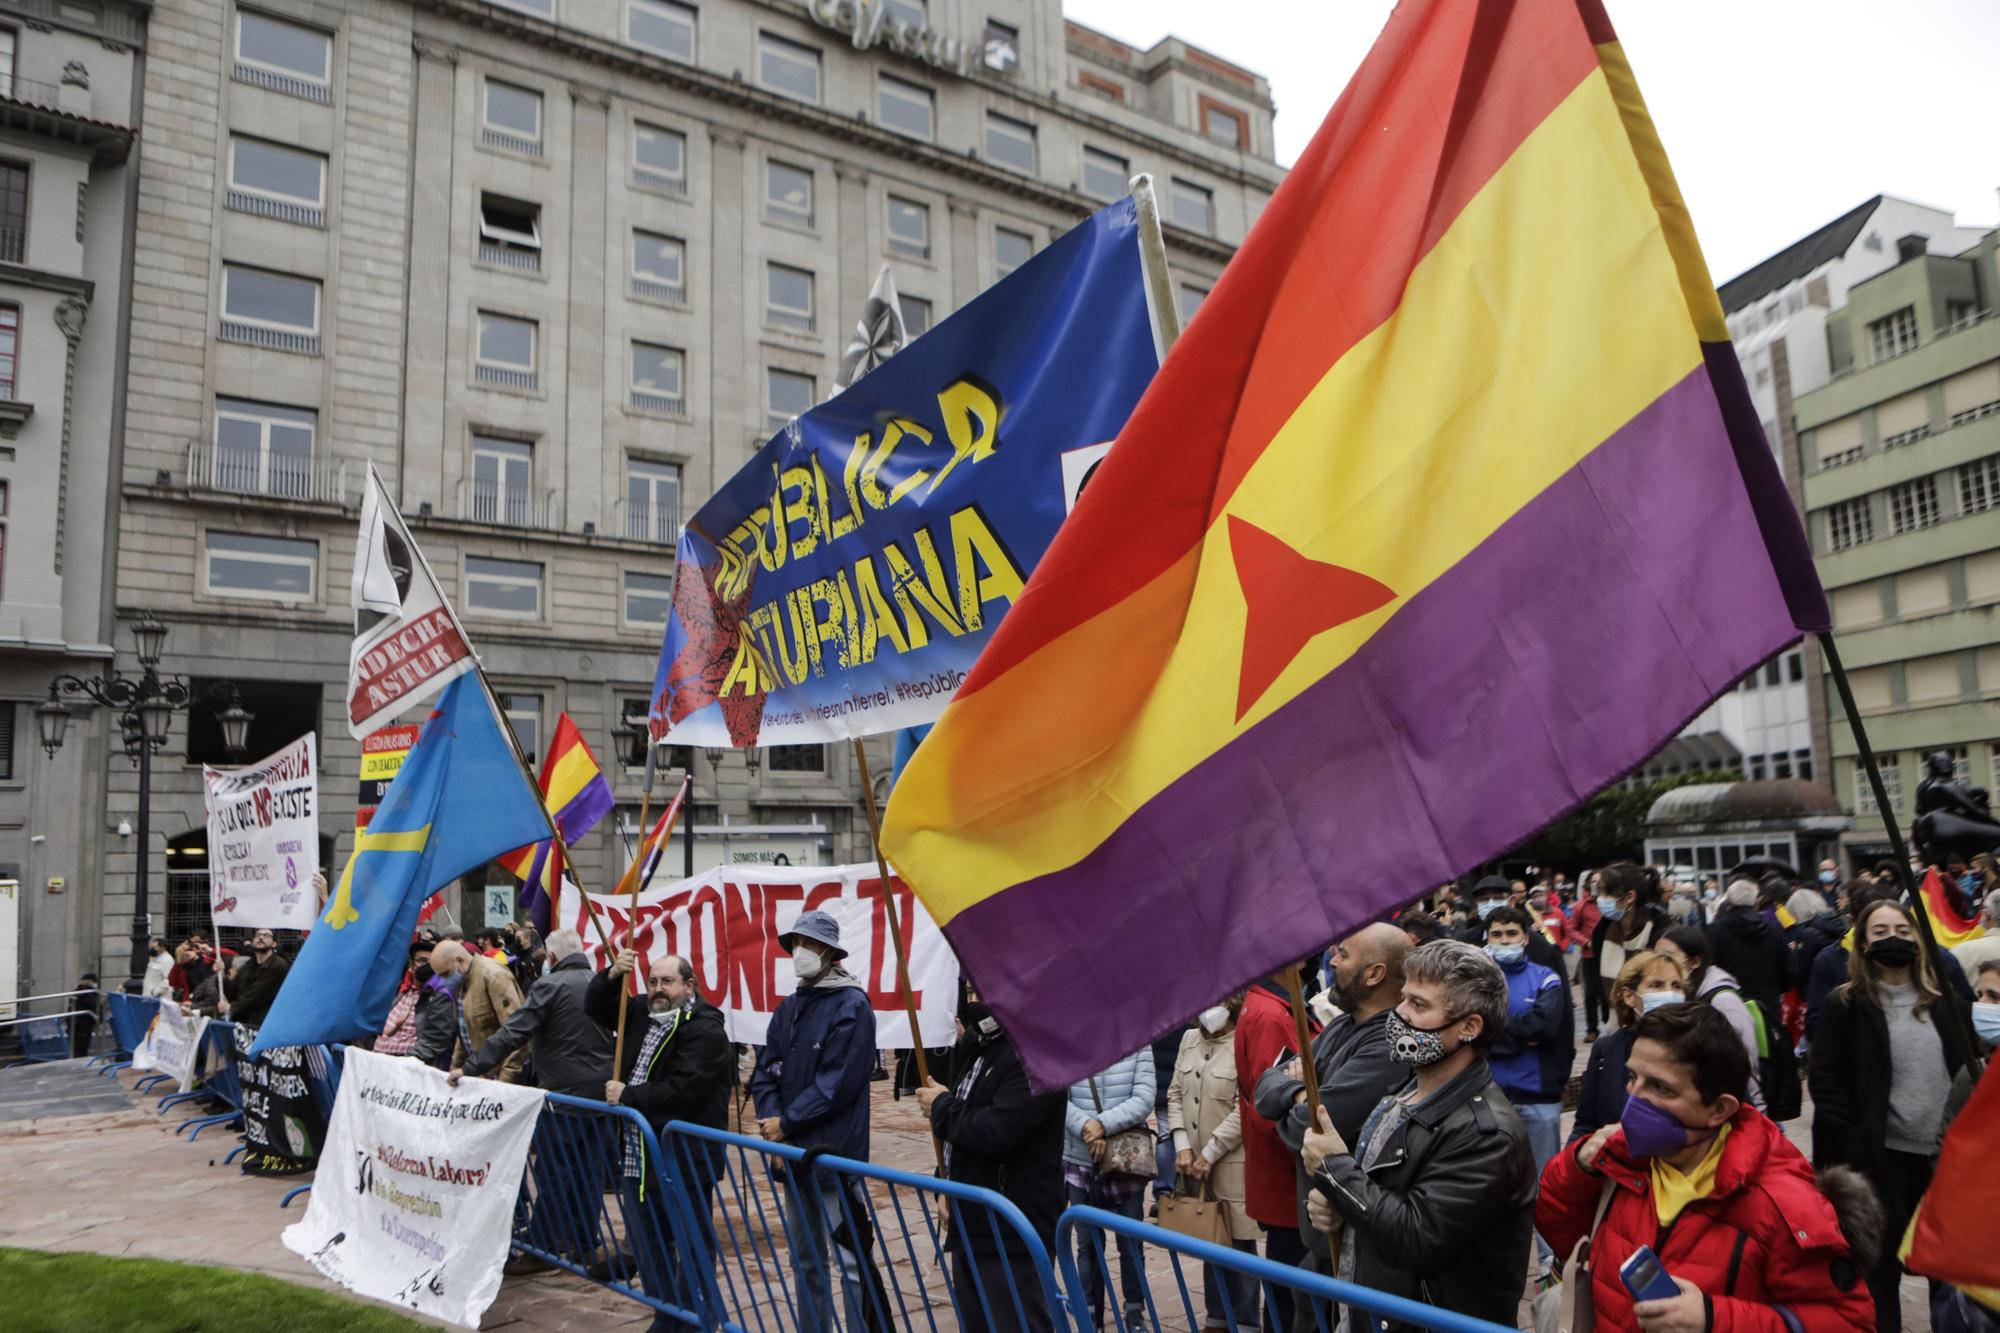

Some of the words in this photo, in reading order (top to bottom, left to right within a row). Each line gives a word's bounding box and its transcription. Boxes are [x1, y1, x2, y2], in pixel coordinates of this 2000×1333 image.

[366, 643, 453, 710] ASTUR
[898, 668, 972, 701] #Repúblic
[236, 800, 256, 831] QUE
[253, 786, 273, 829] NO
[273, 786, 313, 820] EXISTE
[732, 852, 758, 864] SOMOS
[470, 1097, 505, 1122] dice
[427, 1155, 492, 1187] Laboral
